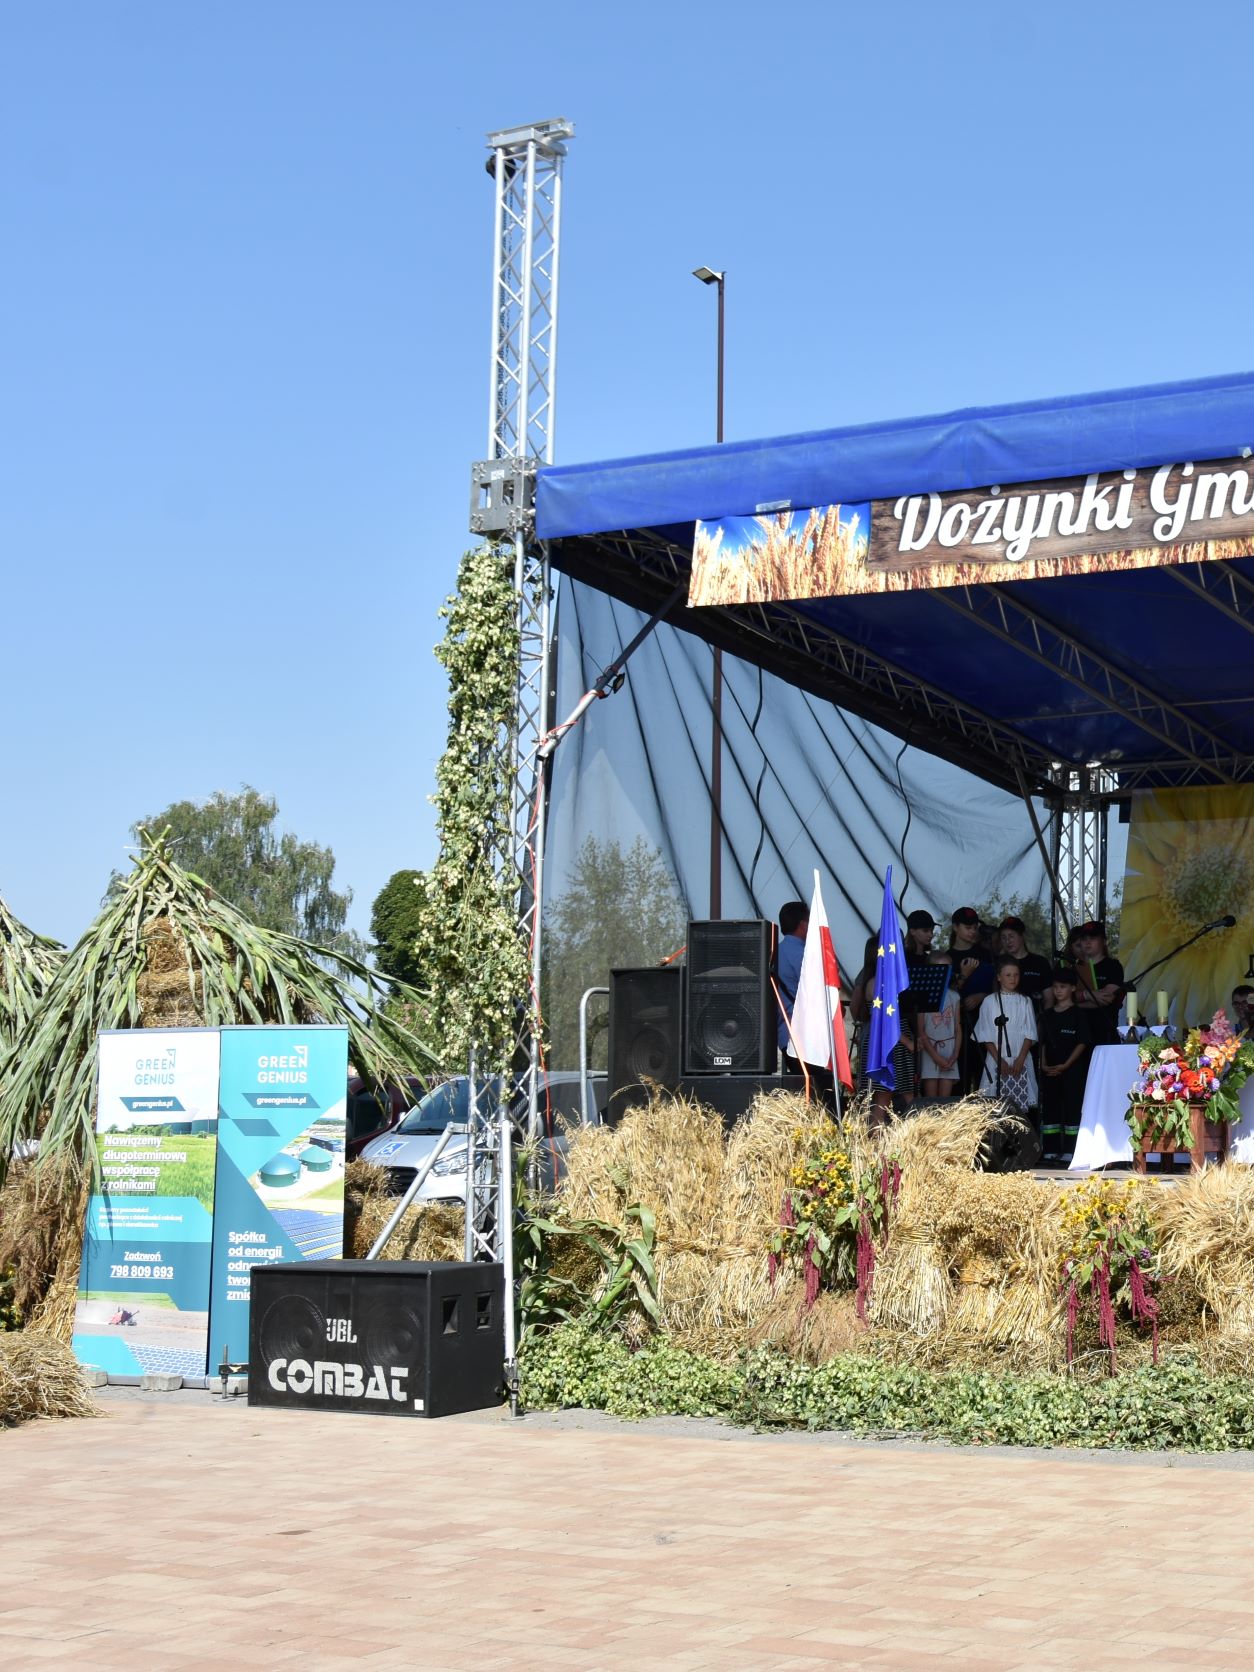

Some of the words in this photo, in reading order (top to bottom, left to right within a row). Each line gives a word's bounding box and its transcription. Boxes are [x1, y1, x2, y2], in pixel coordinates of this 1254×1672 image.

[893, 469, 1136, 561] Dożynki
[135, 1056, 176, 1070] GREEN
[258, 1052, 308, 1068] GREEN
[134, 1074, 175, 1085] GENIUS
[258, 1072, 308, 1084] GENIUS
[256, 1096, 306, 1105] greengenius.pl
[103, 1150, 187, 1163] długoterminową
[102, 1165, 160, 1177] współpracę
[108, 1180, 156, 1190] rolnikami
[228, 1231, 266, 1244] Spółka
[124, 1251, 162, 1261] Zadzwoń
[228, 1246, 243, 1256] od
[245, 1246, 282, 1259] energii
[110, 1266, 128, 1277] 798
[131, 1266, 151, 1277] 809
[153, 1266, 174, 1278] 693
[326, 1318, 358, 1343] JBL
[268, 1358, 409, 1401] COMBAT
